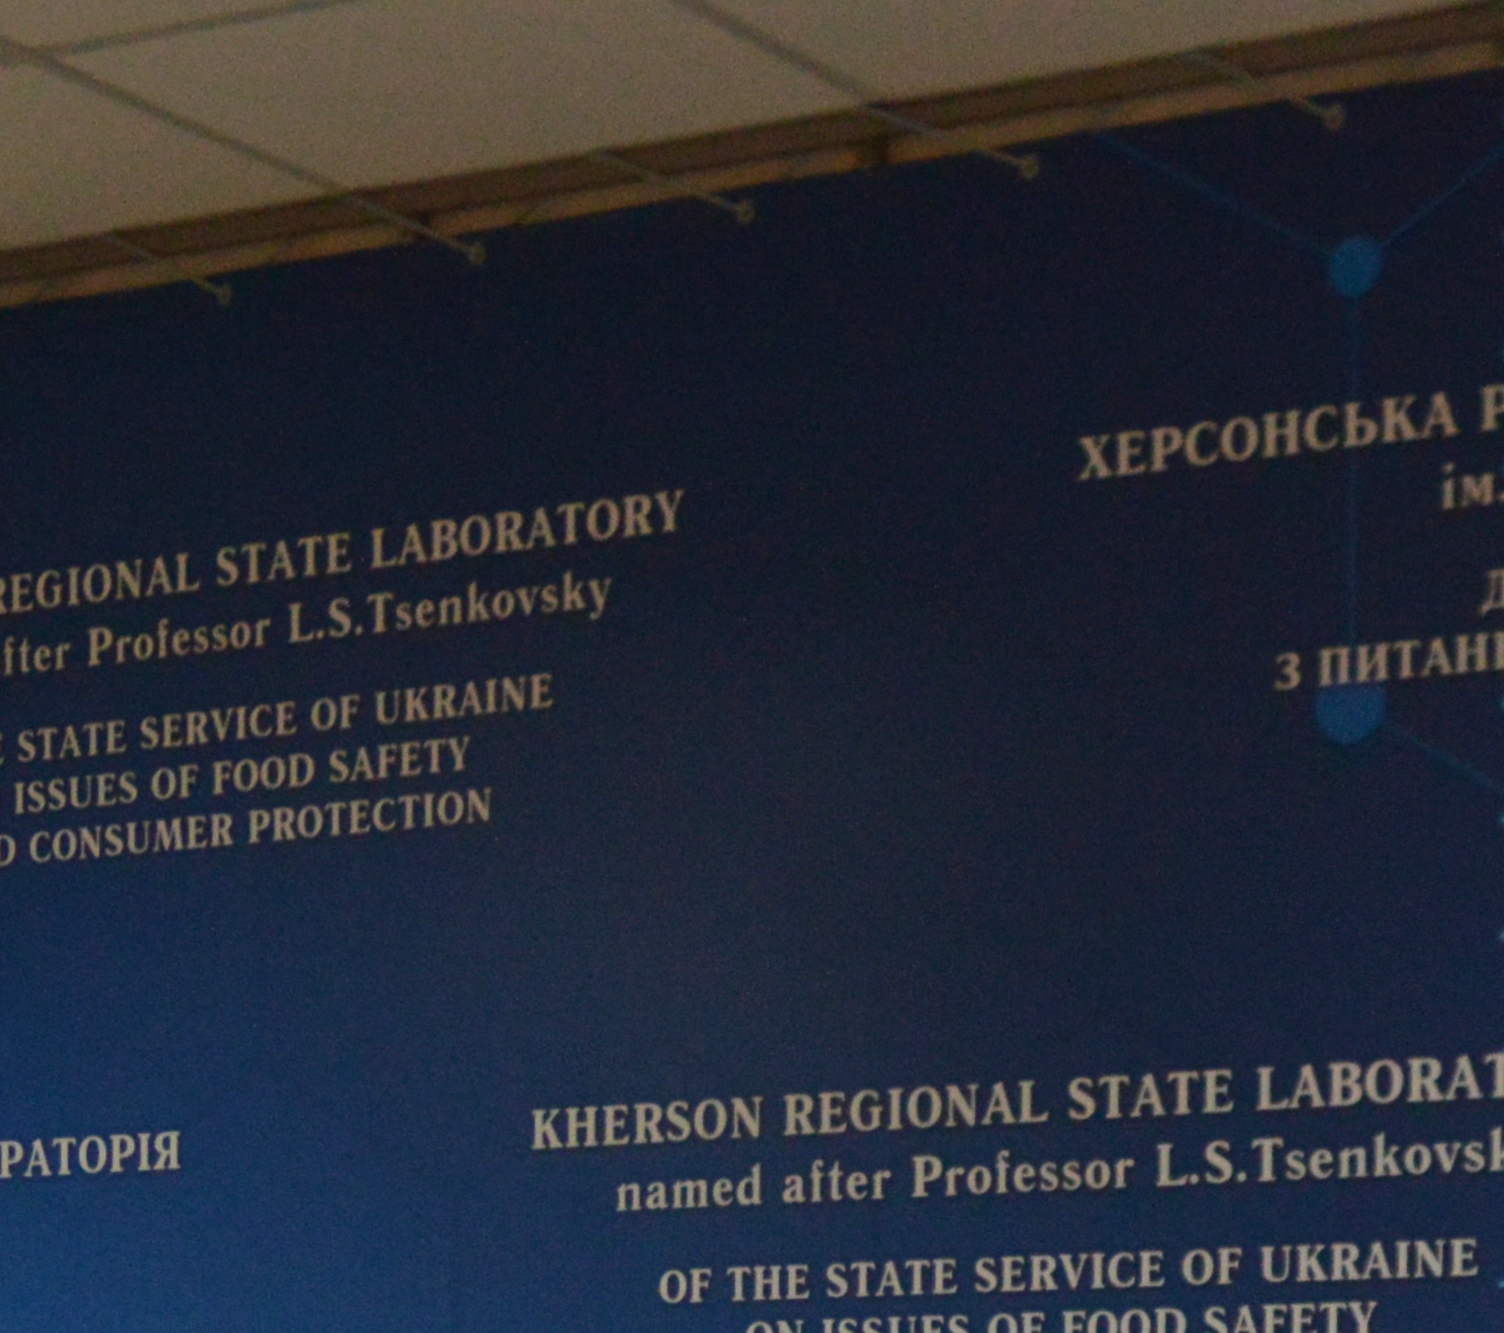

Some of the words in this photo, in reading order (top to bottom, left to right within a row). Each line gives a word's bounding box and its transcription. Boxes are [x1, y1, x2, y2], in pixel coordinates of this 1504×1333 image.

[1077, 389, 1461, 483] ХЕРСОНСЬКА
[213, 530, 354, 588] STATE
[368, 487, 686, 572] LABORATORY
[85, 616, 273, 669] Professor
[287, 569, 613, 646] L.S.Tsenkovsky
[1273, 649, 1304, 693] З
[15, 718, 128, 765] STATE
[137, 698, 299, 751] SERVICE
[307, 692, 362, 733] OF
[373, 670, 555, 727] UKRAINE
[12, 770, 139, 816] ISSUES
[150, 766, 200, 802] OF
[211, 748, 317, 797] FOOD
[327, 734, 473, 785] SAFETY
[27, 801, 236, 864] CONSUMER
[246, 786, 494, 846] PROTECTION
[529, 1093, 765, 1153] KHERSON
[782, 1077, 1051, 1138] REGIONAL
[1065, 1066, 1235, 1123] STATE
[614, 1162, 764, 1214] named
[779, 1157, 894, 1206] after
[910, 1147, 1137, 1200] Professor
[656, 1266, 713, 1306] OF
[725, 1261, 812, 1304] THE
[823, 1255, 959, 1300] STATE
[972, 1247, 1167, 1295] SERVICE
[1178, 1244, 1245, 1288] OF
[1258, 1235, 1481, 1285] UKRAINE
